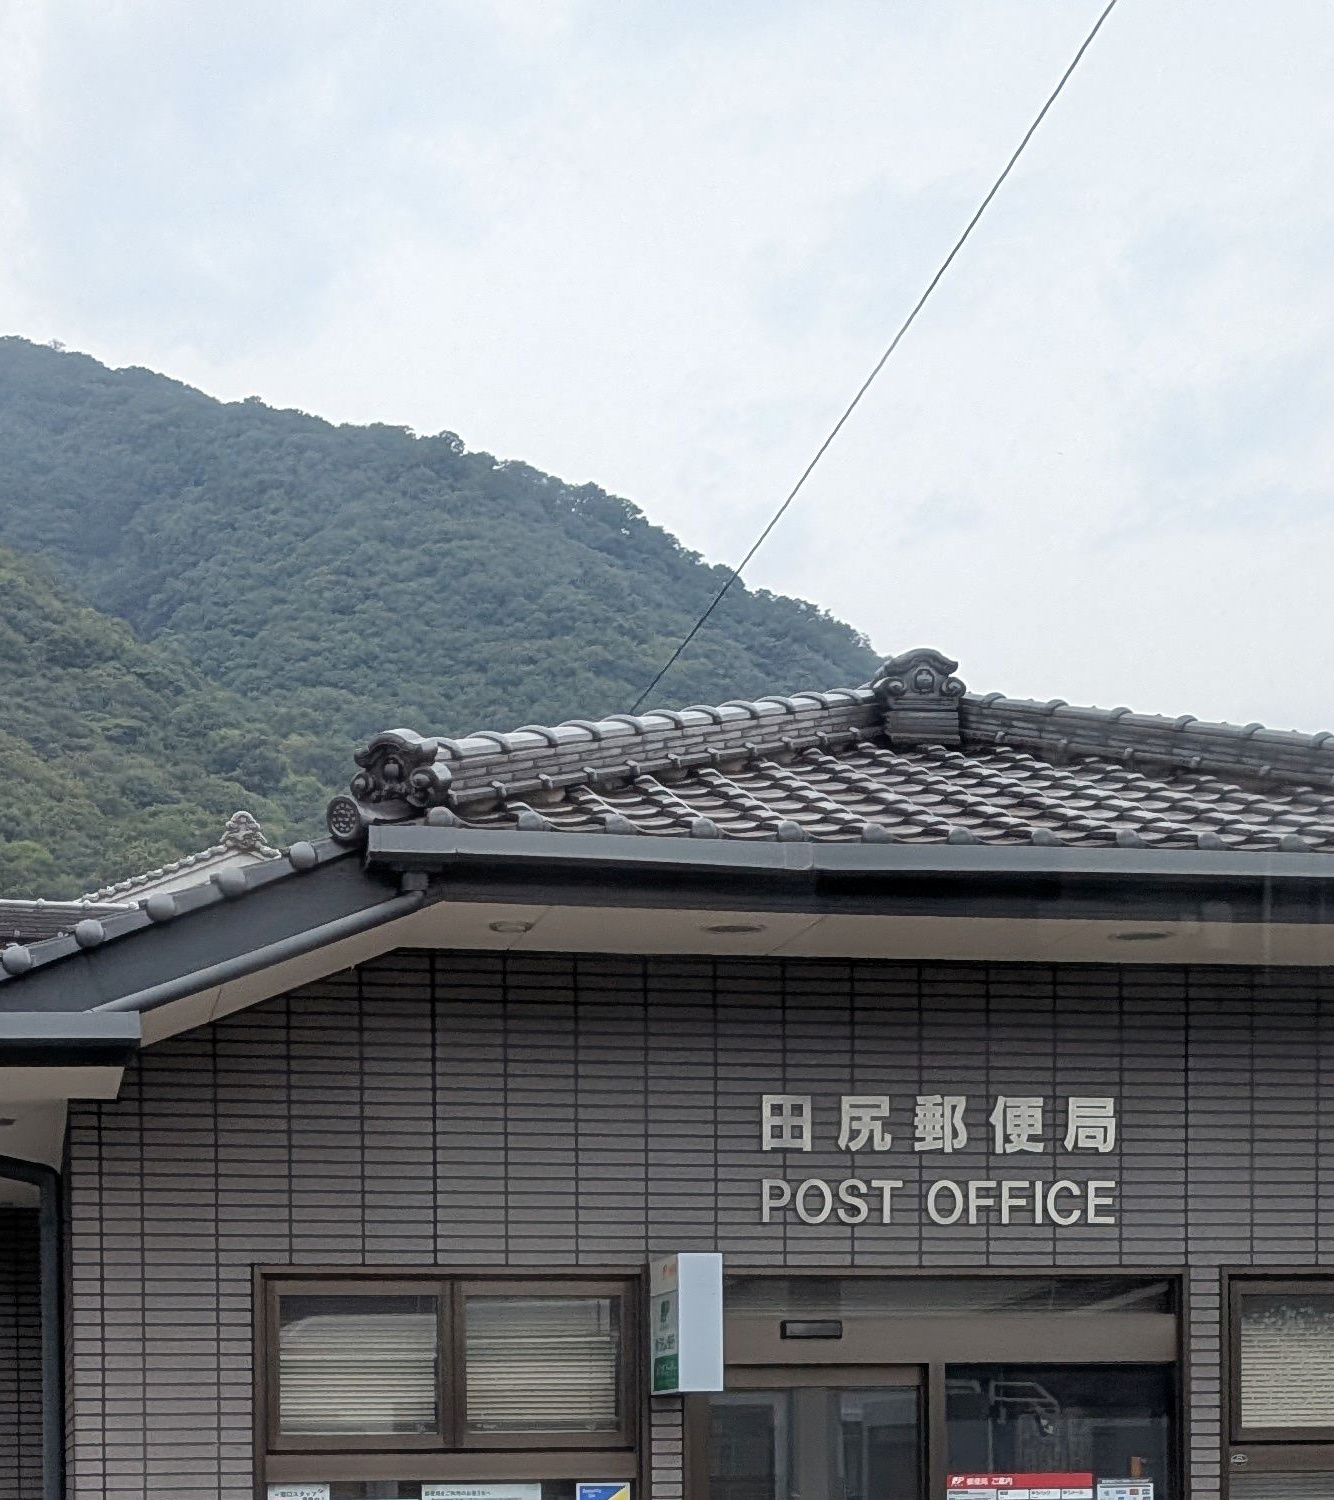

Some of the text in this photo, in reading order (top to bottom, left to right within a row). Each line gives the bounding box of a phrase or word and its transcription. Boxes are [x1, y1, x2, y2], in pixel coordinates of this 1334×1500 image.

[761, 1094, 1117, 1154] 田尻郵便局
[761, 1178, 1117, 1226] POST OFFICE
